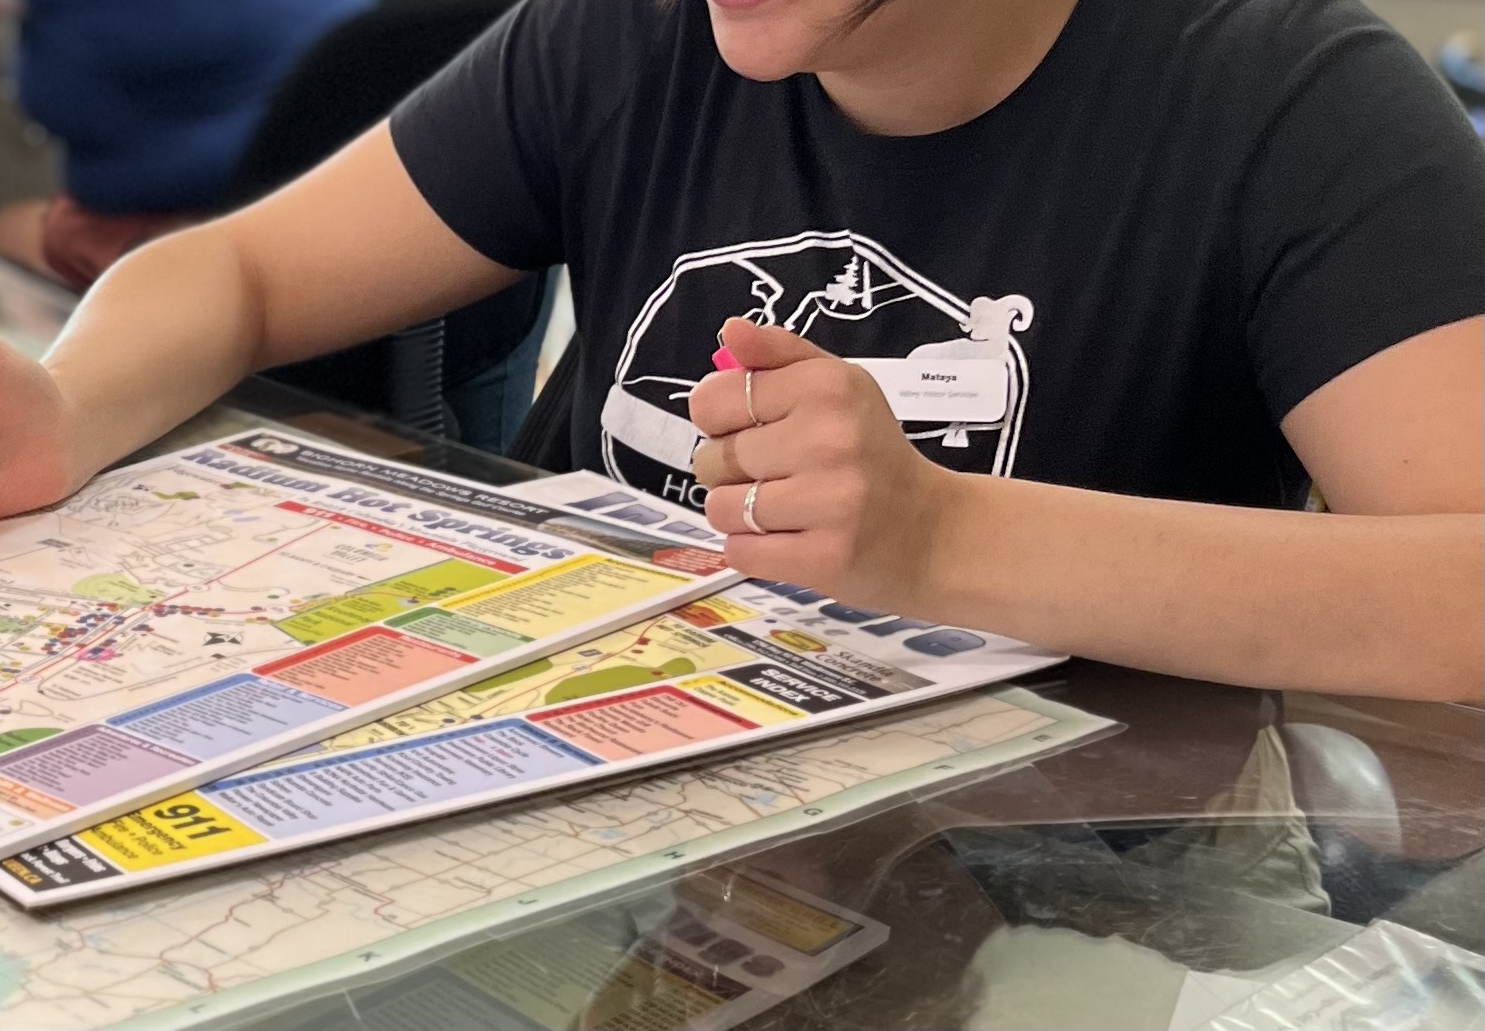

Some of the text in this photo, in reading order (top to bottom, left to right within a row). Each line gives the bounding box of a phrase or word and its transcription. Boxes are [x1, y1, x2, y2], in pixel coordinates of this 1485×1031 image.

[920, 373, 957, 383] Mataya
[298, 450, 550, 514] BIGHORN MEADOWS RESORT
[182, 448, 330, 492] Radium
[326, 487, 412, 513] Hot
[408, 509, 574, 559] Springs
[427, 542, 498, 566] Ambulance
[812, 653, 884, 682] Concrete
[833, 651, 897, 677] Skandia
[747, 676, 813, 702] INDEX
[757, 667, 843, 702] SERVICE
[126, 810, 188, 851] Emergency
[154, 804, 232, 840] 911
